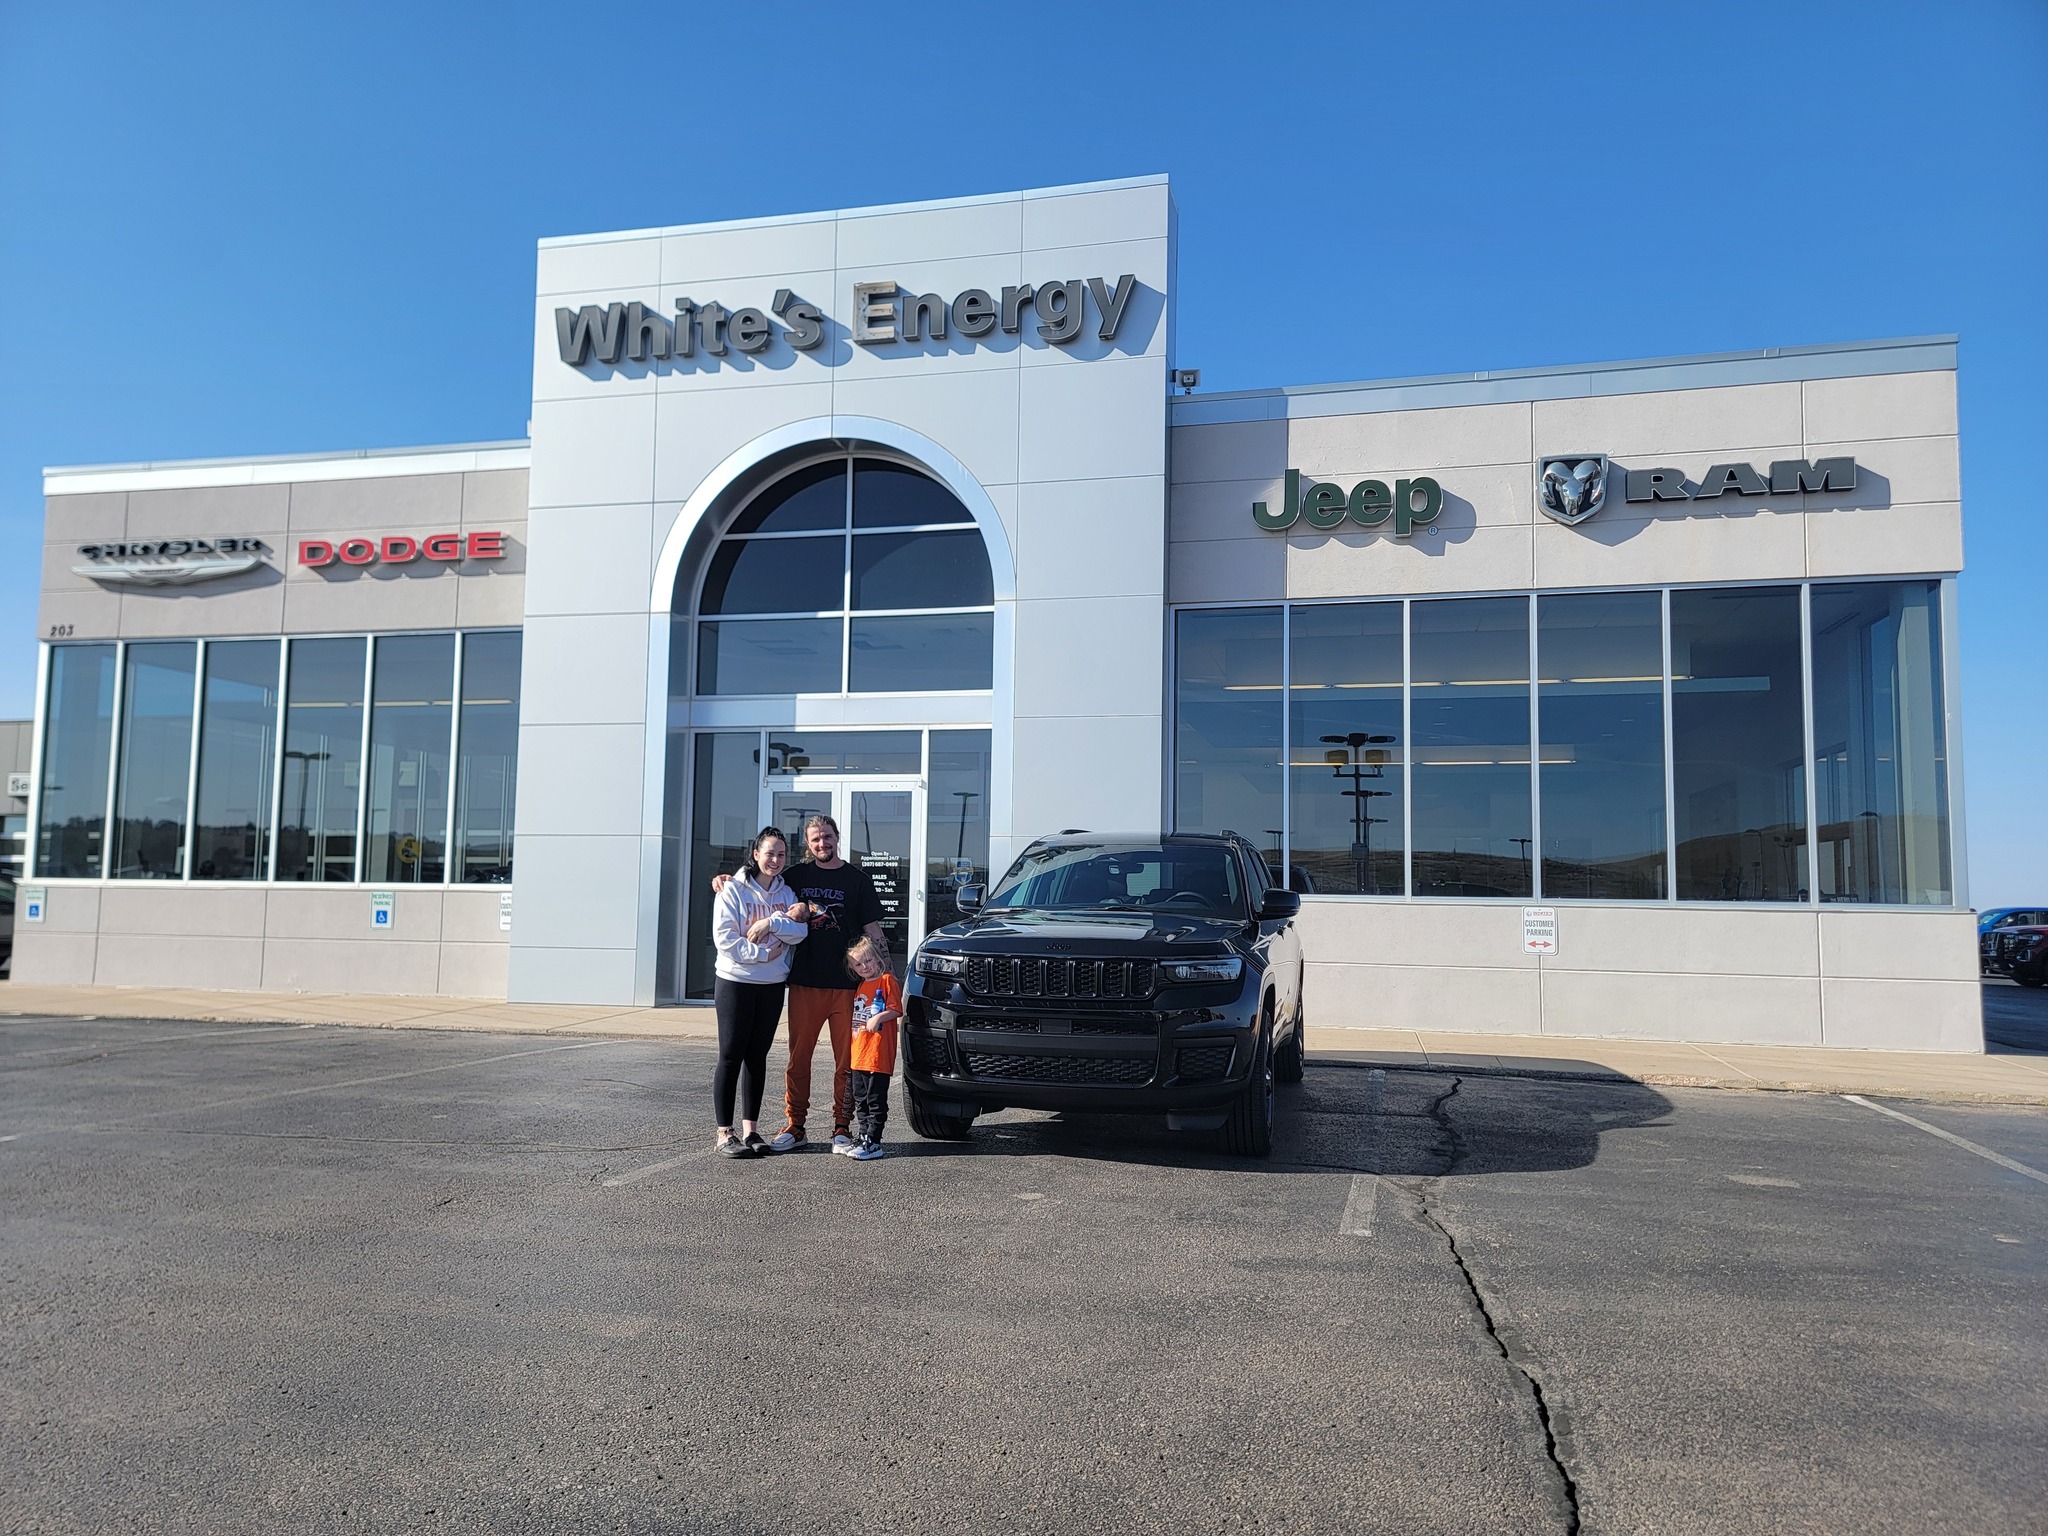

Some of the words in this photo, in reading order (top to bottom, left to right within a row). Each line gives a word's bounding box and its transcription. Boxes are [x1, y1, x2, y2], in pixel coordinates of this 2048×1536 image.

[555, 289, 825, 367] White's
[852, 274, 1137, 345] Energy
[1625, 456, 1856, 504] RAM
[1251, 468, 1443, 538] Jeep
[77, 537, 263, 559] CHRYSLER
[298, 531, 507, 567] DODGE
[50, 625, 74, 637] 203
[800, 888, 845, 900] PRIMUS
[1525, 919, 1554, 928] CUSTOMER
